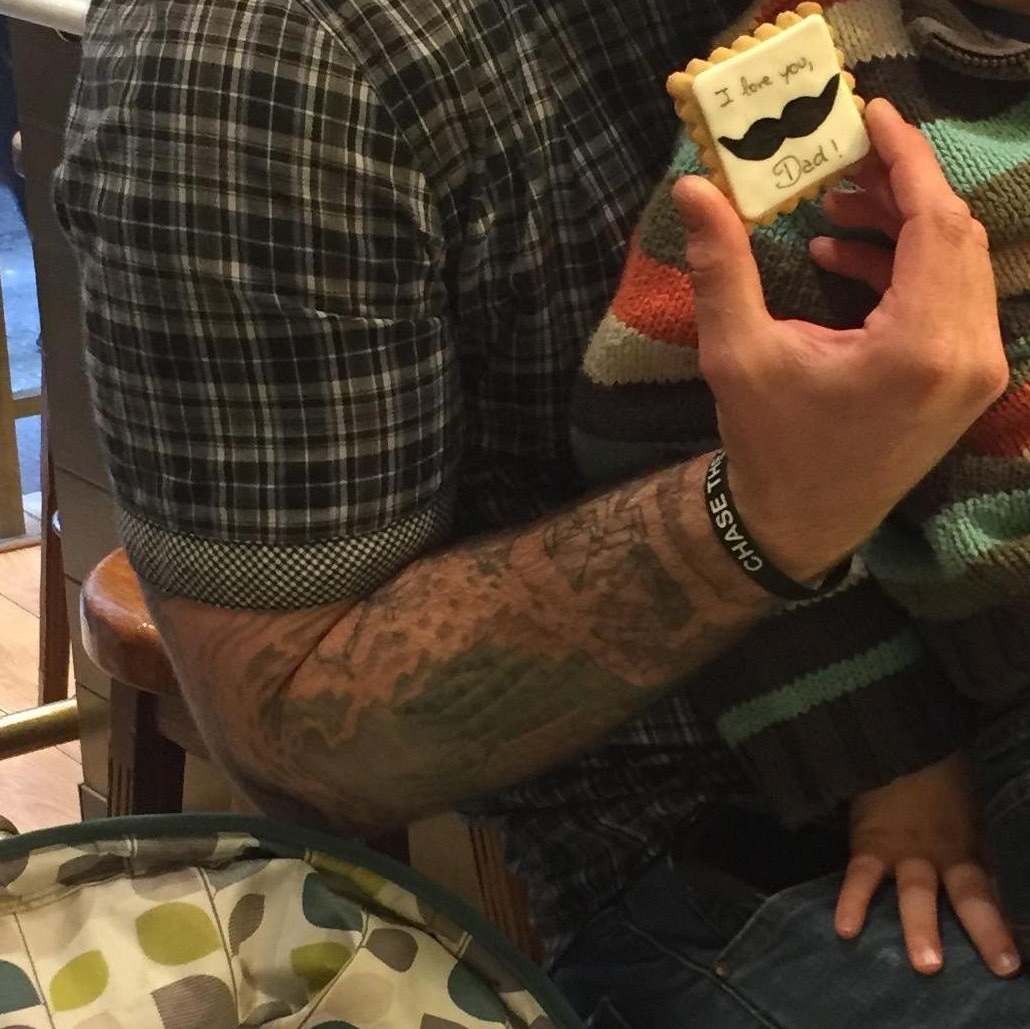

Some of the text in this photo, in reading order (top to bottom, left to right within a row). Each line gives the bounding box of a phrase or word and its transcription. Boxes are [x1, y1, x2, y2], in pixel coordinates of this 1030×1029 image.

[714, 87, 734, 108] I
[740, 76, 773, 97] love
[709, 493, 763, 571] CHASE
